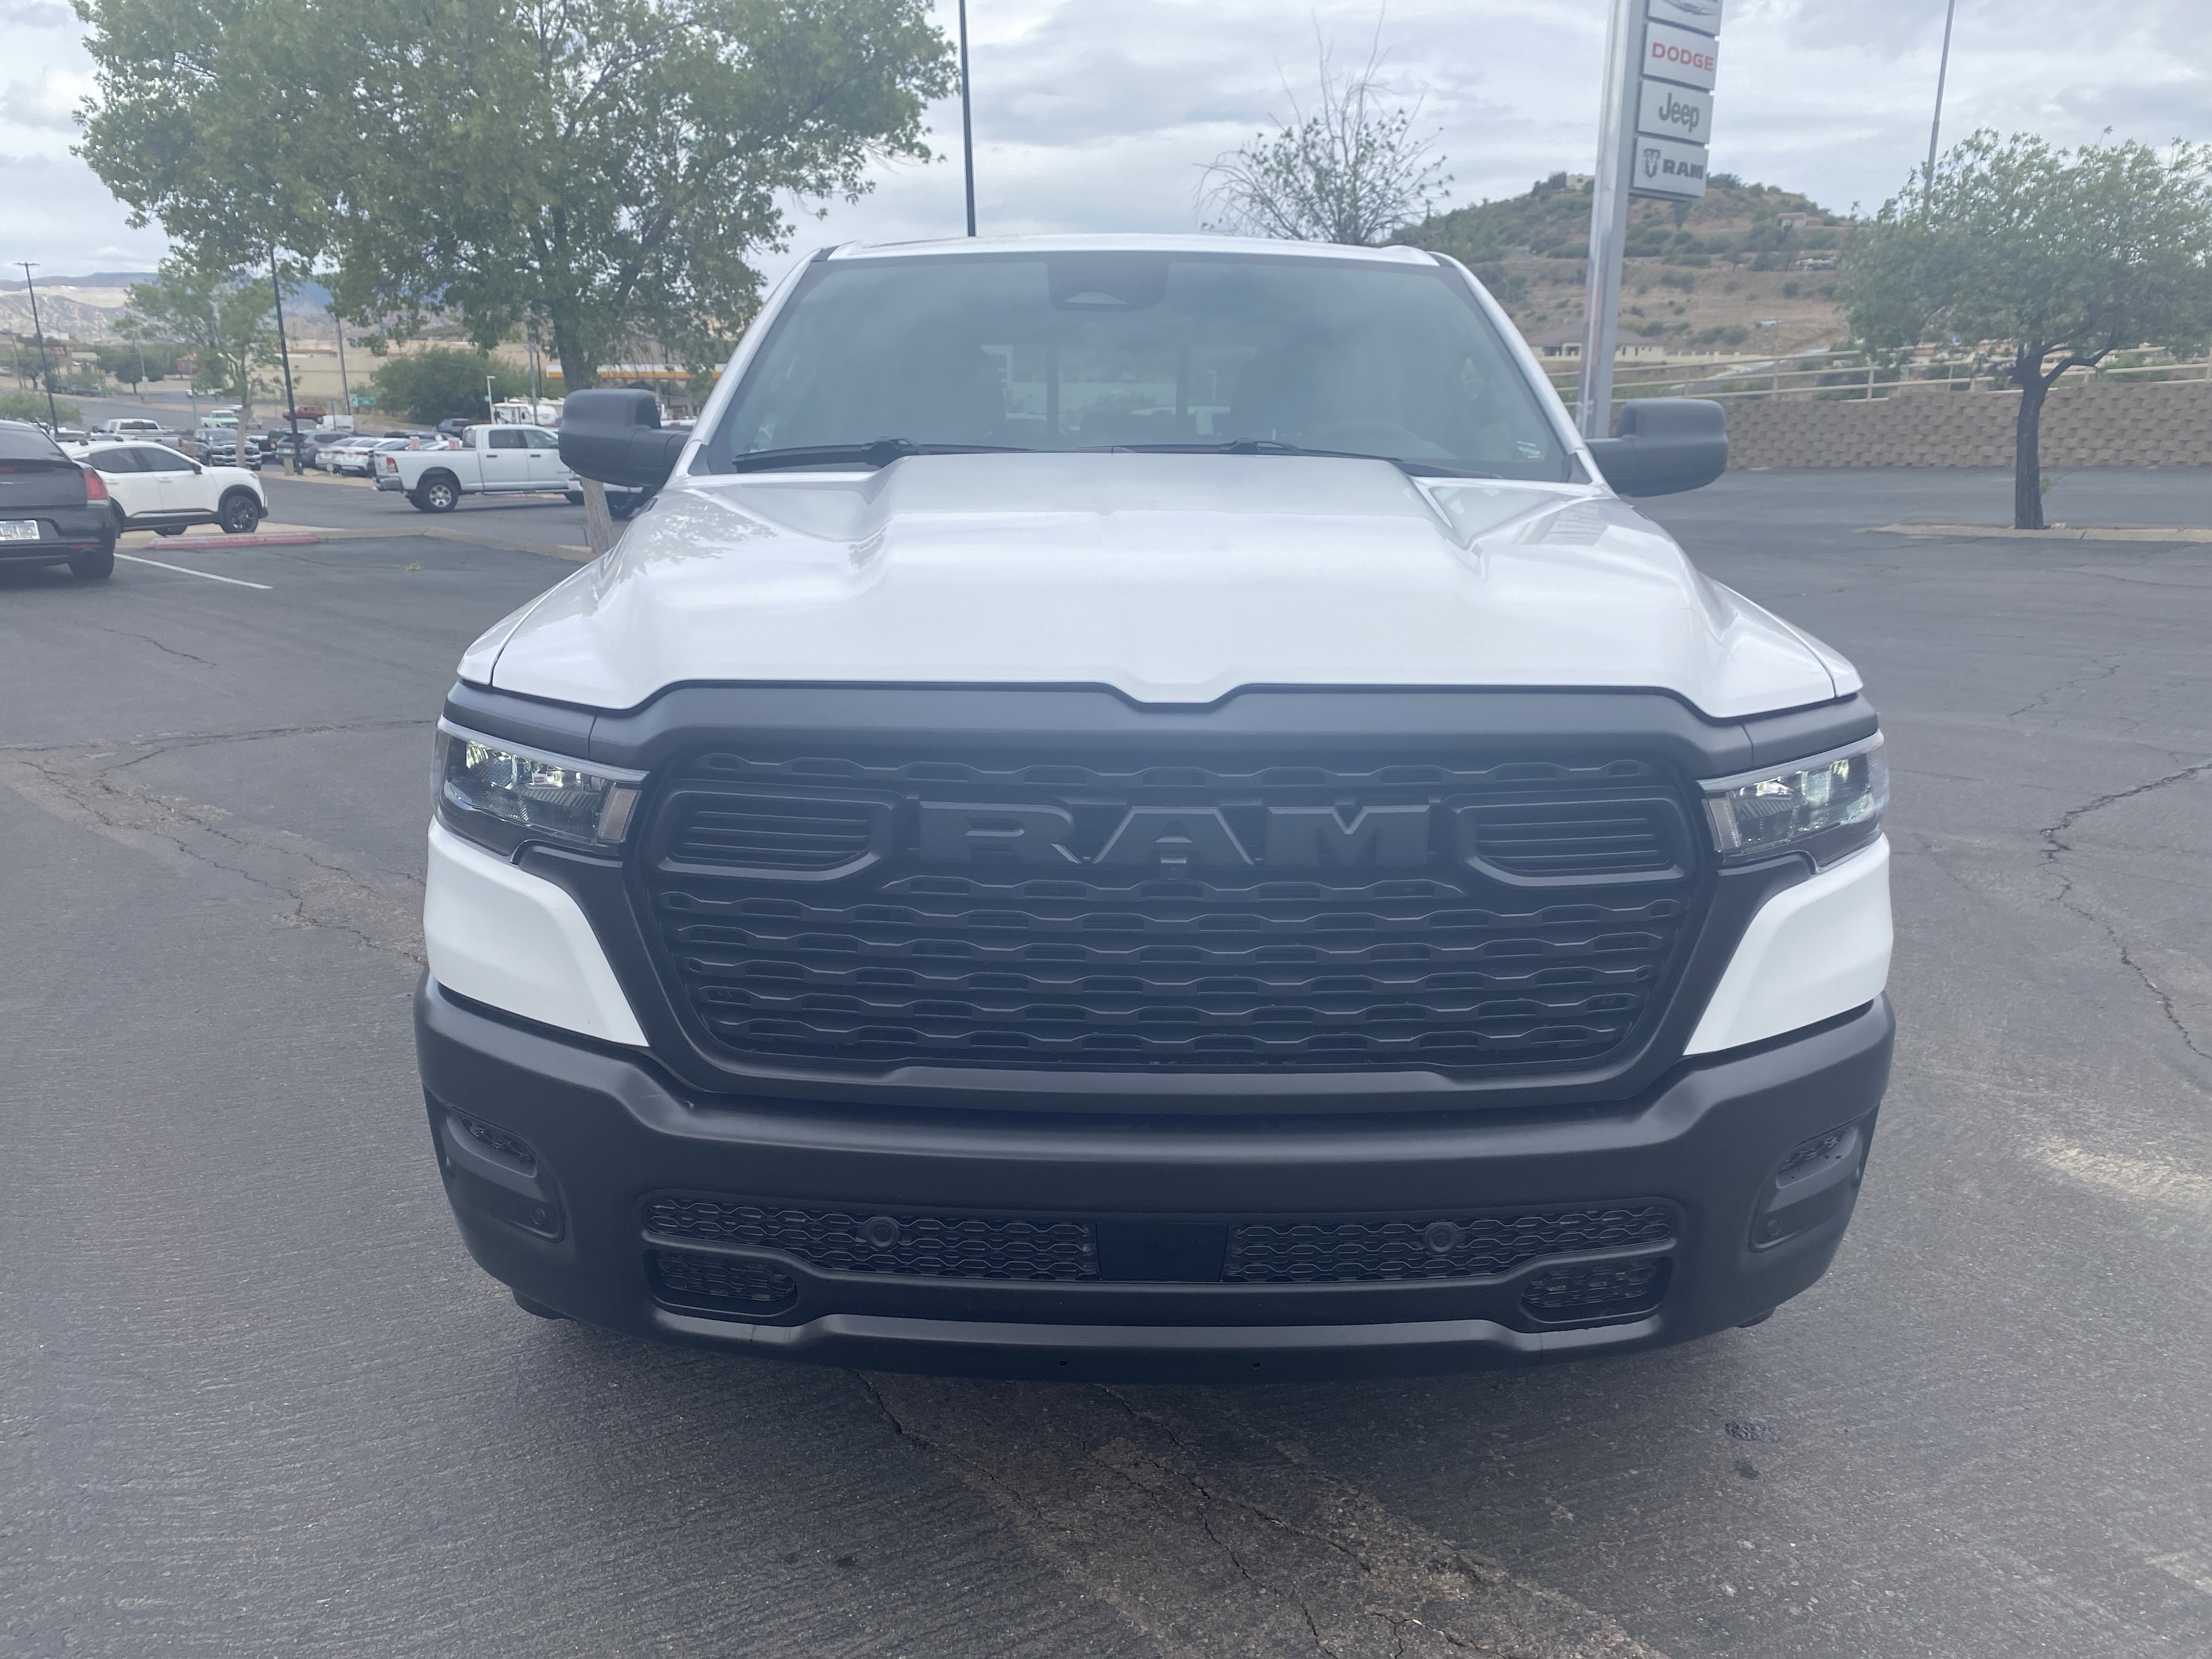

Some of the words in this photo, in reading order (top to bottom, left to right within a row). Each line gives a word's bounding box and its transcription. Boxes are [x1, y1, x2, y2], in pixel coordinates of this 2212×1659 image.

[1652, 42, 1714, 71] DODGE
[1658, 92, 1700, 132] Jeep
[1662, 158, 1704, 179] RAM
[919, 800, 1430, 866] RAM
